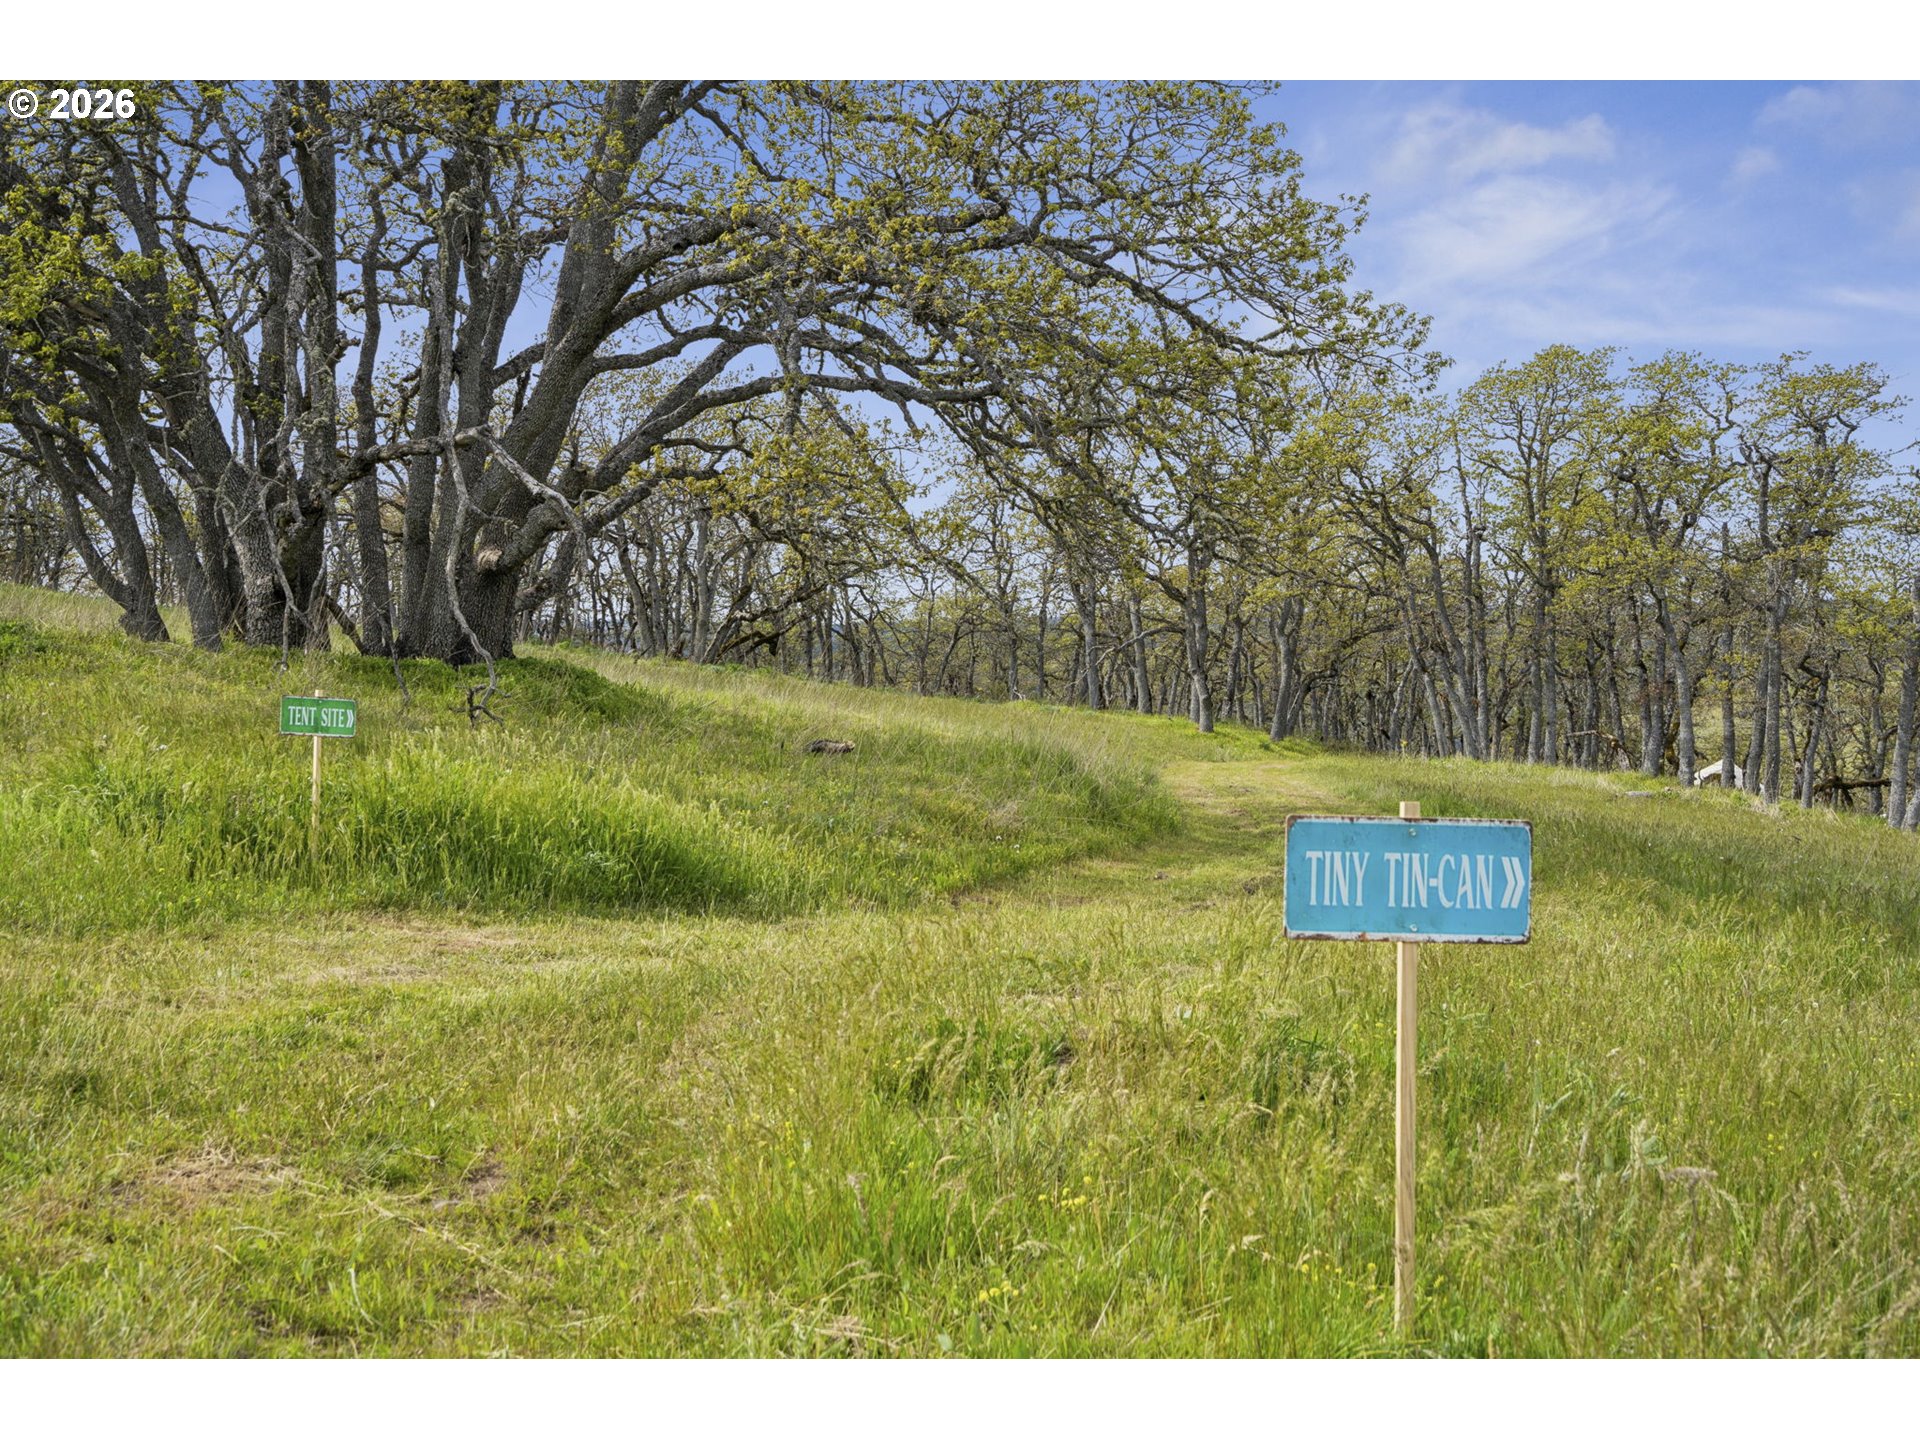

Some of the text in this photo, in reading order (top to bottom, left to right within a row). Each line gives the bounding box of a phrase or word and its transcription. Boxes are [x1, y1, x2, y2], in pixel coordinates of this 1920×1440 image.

[288, 706, 345, 728] TENT SITE
[1305, 851, 1494, 910] TINY TIN-CAN
